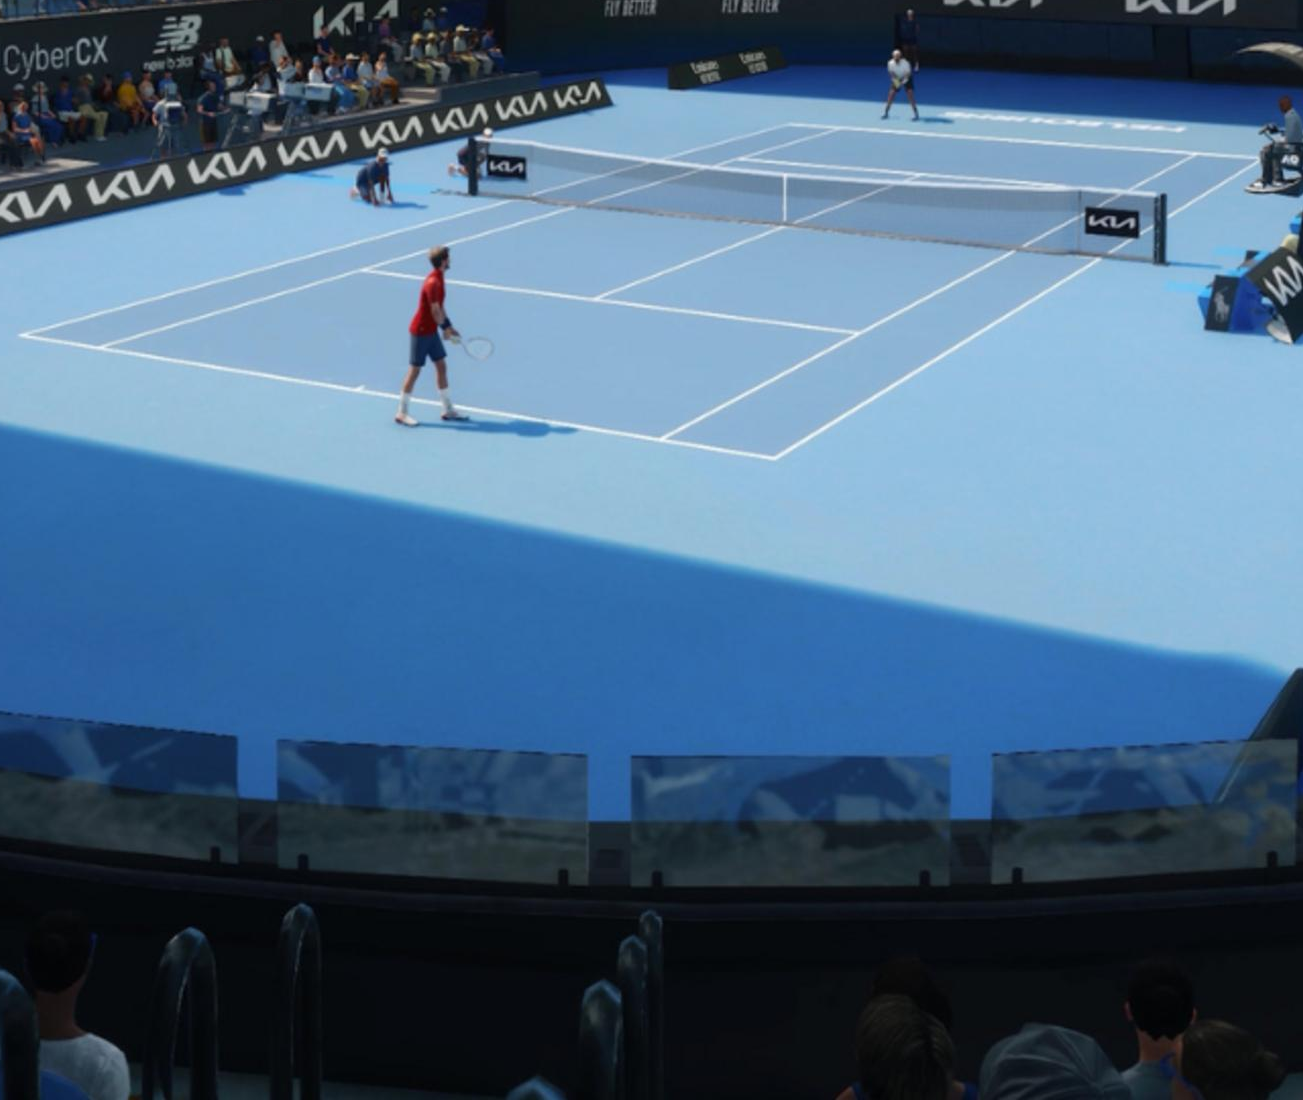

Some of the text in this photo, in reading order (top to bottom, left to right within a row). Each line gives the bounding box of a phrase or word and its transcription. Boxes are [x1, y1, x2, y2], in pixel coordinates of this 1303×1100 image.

[604, 0, 620, 17] FLY
[4, 35, 108, 80] CyberCX
[495, 92, 548, 121] KIA
[554, 81, 601, 106] KIA
[360, 117, 423, 150] KIA
[431, 104, 488, 136] KIA
[276, 130, 347, 167] KIA
[188, 146, 266, 184] KIA
[489, 159, 524, 173] KIA
[86, 163, 175, 206] KIA
[1089, 213, 1136, 230] KIA
